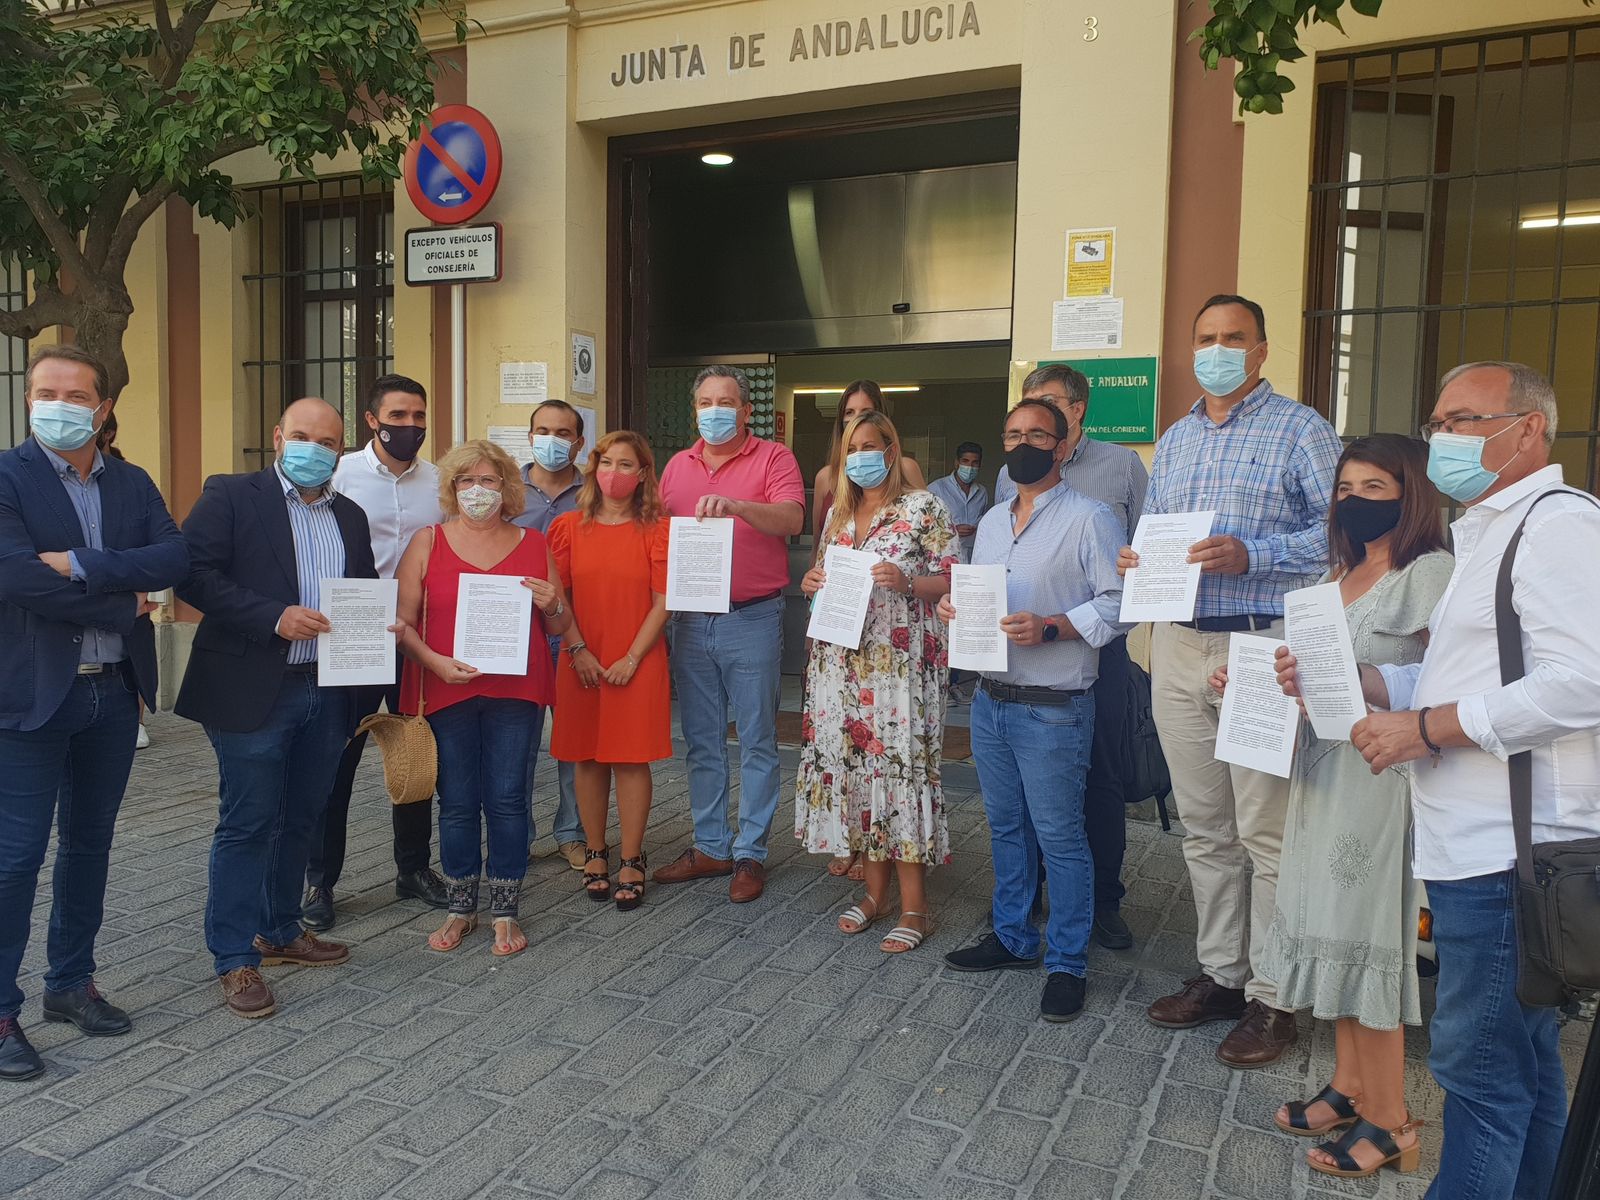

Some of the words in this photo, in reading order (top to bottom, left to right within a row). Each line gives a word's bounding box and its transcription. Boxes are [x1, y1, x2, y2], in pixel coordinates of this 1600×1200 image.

[1083, 16, 1099, 42] 3
[611, 44, 705, 87] JUNTA
[729, 32, 766, 70] DE
[789, 1, 981, 62] ANDALUCIA
[411, 237, 446, 247] EXCEPTO
[449, 234, 493, 244] VEHÍCULOS
[424, 250, 465, 260] OFICIALES
[468, 249, 478, 257] DE
[427, 262, 476, 273] CONSEJERÍA
[1112, 426, 1147, 434] GOBIERNO
